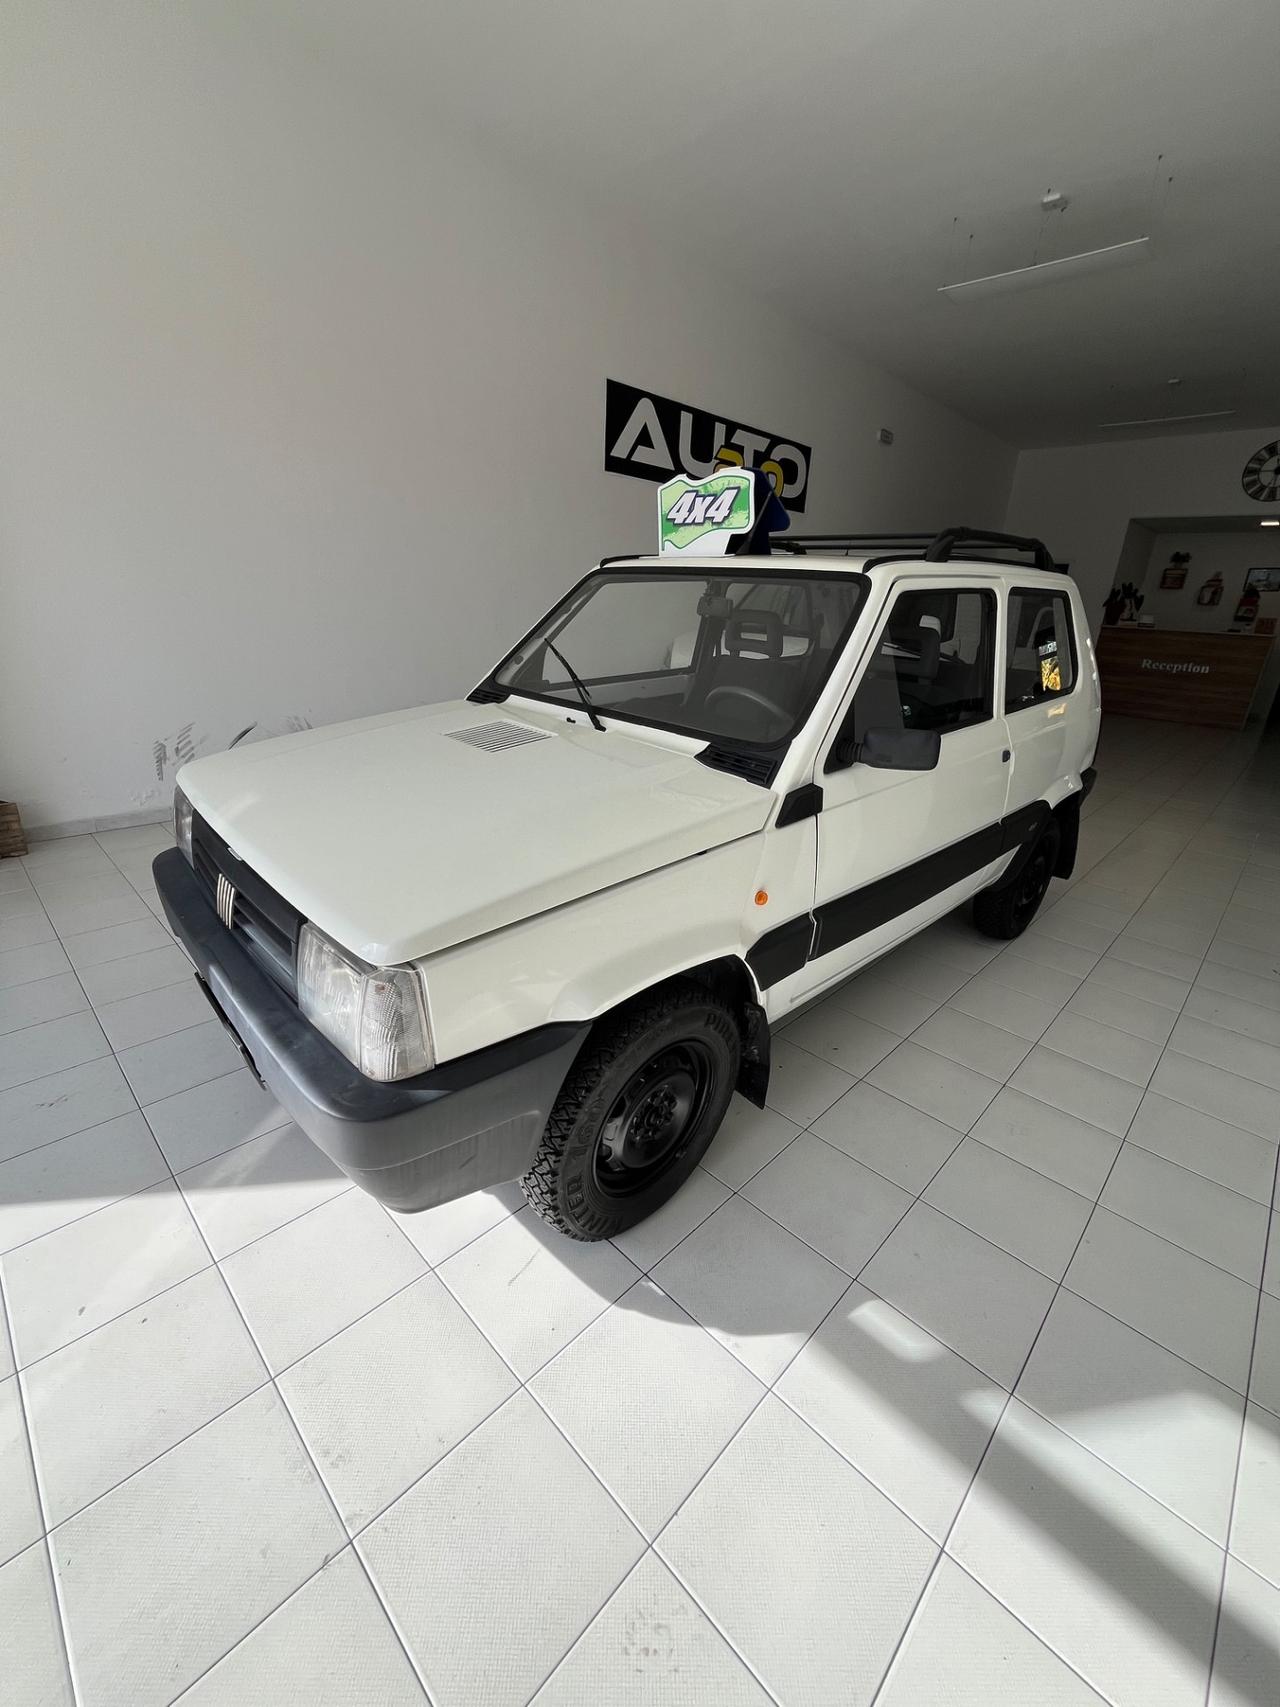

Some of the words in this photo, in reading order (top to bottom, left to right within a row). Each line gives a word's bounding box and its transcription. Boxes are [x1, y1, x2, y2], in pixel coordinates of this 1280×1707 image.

[610, 397, 806, 498] AUTO
[667, 486, 741, 526] 4x4
[1141, 659, 1209, 673] Reception
